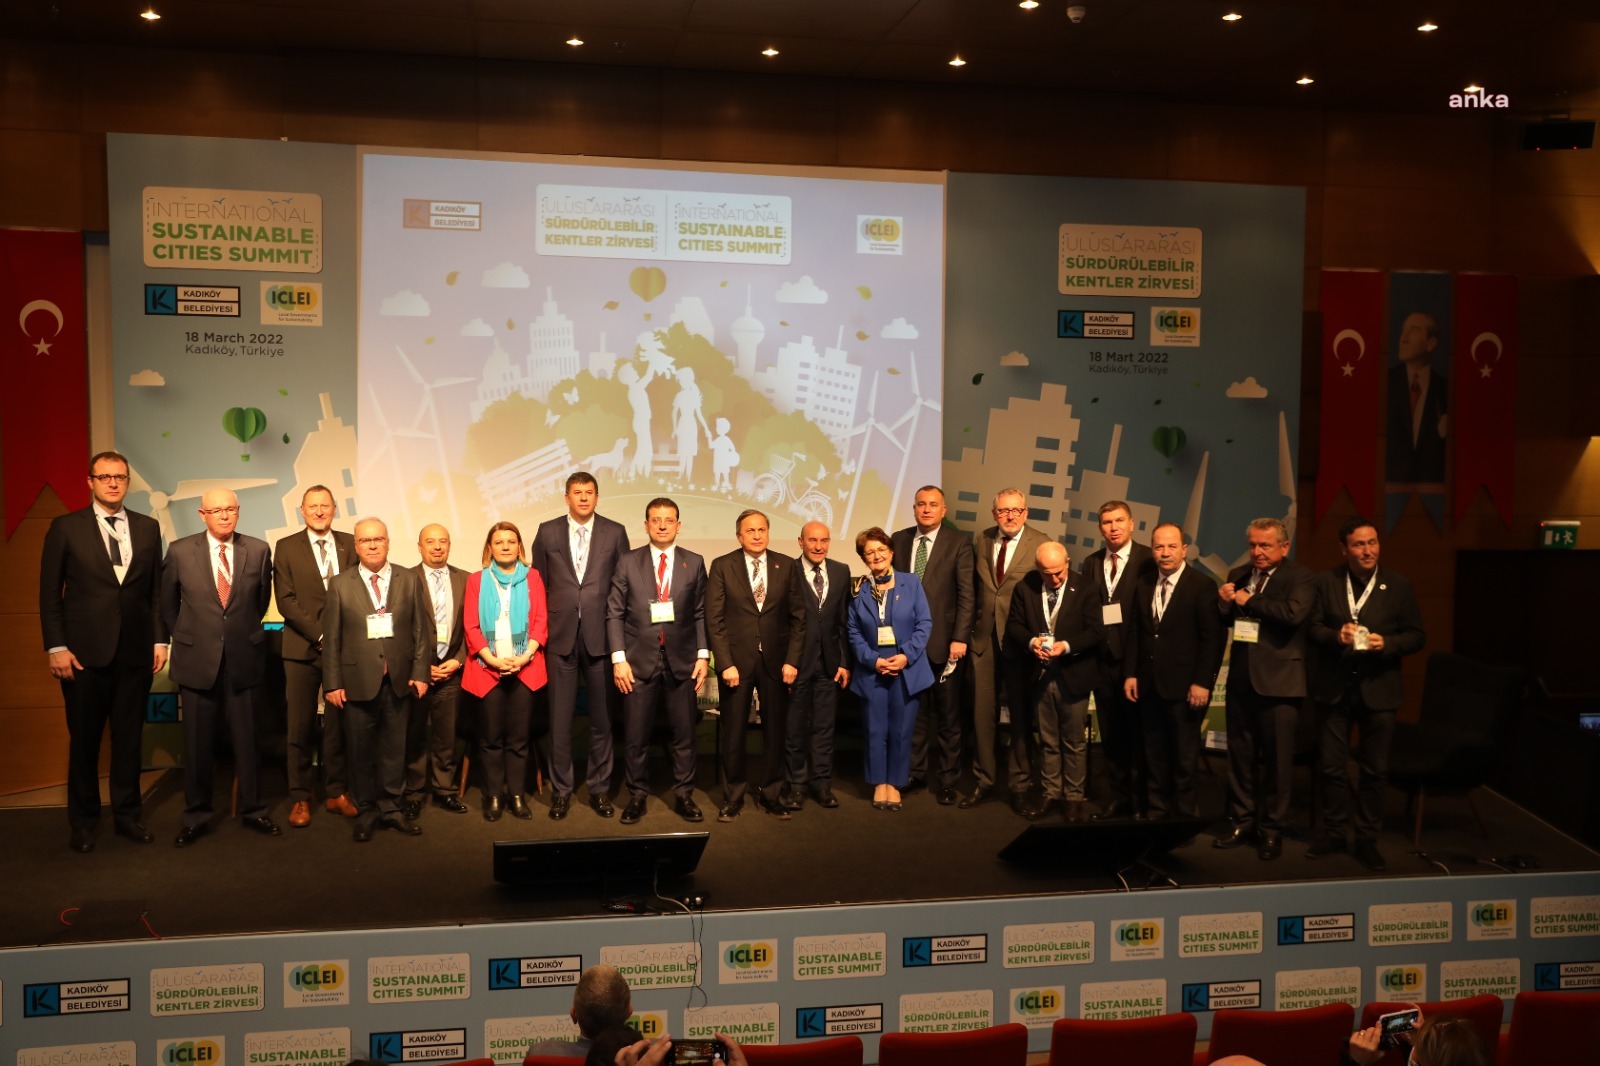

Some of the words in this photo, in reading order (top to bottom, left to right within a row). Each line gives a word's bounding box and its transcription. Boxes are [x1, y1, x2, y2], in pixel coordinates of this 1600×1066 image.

[152, 201, 314, 224] INTERNATIONAL
[435, 204, 466, 213] KADIKÖY
[545, 200, 655, 217] ULUSLARARASI
[678, 206, 783, 223] INTERNATIONAL
[434, 218, 476, 228] BELEDİYESİ
[545, 217, 655, 233] SÜRDÜRÜLEBİLİR
[865, 223, 895, 236] ICLEI
[152, 222, 314, 245] SUSTAINABLE
[678, 222, 784, 239] SUSTAINABLE
[545, 234, 603, 247] KENTLER
[606, 234, 655, 249] ZİRVESİ
[678, 239, 724, 252] CITIES
[727, 241, 782, 254] SUMMIT
[1066, 237, 1196, 255] ULUSLARARASI
[152, 244, 223, 261] CITIES
[228, 246, 313, 264] SUMMIT
[1066, 255, 1195, 272] SÜRDÜRÜLEBİLİR
[1066, 276, 1134, 288] KENTLER
[1138, 275, 1194, 290] ZİRVESİ
[183, 289, 221, 298] KADIKÖY
[271, 290, 311, 305] ICLEI
[183, 303, 233, 313] BELEDİYESİ
[1089, 314, 1119, 322] KADIKÖY
[1160, 315, 1191, 328] ICLEI
[185, 332, 199, 342] 18
[204, 332, 245, 344] March
[249, 333, 284, 345] 2022
[1088, 328, 1129, 336] BELEDİYESİ
[185, 344, 238, 357] Kadıköy,
[240, 345, 284, 357] Türkiye
[1090, 352, 1102, 362] 18
[1107, 352, 1134, 362] Mart
[1138, 353, 1169, 363] 2022
[1133, 365, 1168, 375] Türkiye
[1476, 908, 1507, 921] ICLEI
[1534, 912, 1600, 924] SUSTAINABL
[1309, 918, 1339, 926] KADIKÖY
[1373, 920, 1449, 932] SÜRDÜRÜLEBİLİR
[1534, 925, 1565, 934] CITIES
[1567, 923, 1600, 933] SUMMI
[1008, 928, 1090, 942] ULUSLARARASI
[1120, 927, 1154, 941] ICLEI
[1183, 930, 1259, 943] SUSTAINABLE
[1309, 930, 1349, 940] BELEDİYESİ
[1373, 932, 1412, 943] KENTLER
[1415, 931, 1449, 941] ZİRVESİ
[797, 940, 881, 953] INTERNATIONAL
[936, 938, 971, 948] KADIKÖY
[1008, 940, 1090, 954] SÜRDÜRÜLEBİLİR
[1183, 943, 1216, 954] CITIES
[1218, 940, 1258, 952] SUMMIT
[729, 949, 767, 963] ICLEI
[798, 951, 882, 965] SUSTAINABLE
[936, 952, 981, 961] BELEDİYESİ
[1008, 953, 1051, 964] KENTLER
[1054, 950, 1090, 962] ZİRVESİ
[372, 961, 466, 975] INTERNATIONAL
[526, 960, 564, 970] KADIKÖY
[798, 965, 834, 976] CITIES
[837, 963, 881, 974] SUMMIT
[1564, 965, 1594, 973] KADIKÖY
[156, 971, 259, 988] ULUSLARARASI
[295, 970, 337, 985] ICLEI
[372, 973, 466, 987] SUSTAINABLE
[526, 973, 575, 984] BELEDİYESİ
[1385, 972, 1417, 986] ICLEI
[1444, 975, 1517, 988] SUSTAINABLE
[1564, 977, 1600, 986] BELEDİYES
[67, 984, 109, 995] KADIKÖY
[156, 984, 258, 999] SÜRDÜRÜLEBİLİR
[373, 987, 413, 999] CITIES
[416, 985, 465, 997] SUMMIT
[1214, 985, 1245, 994] KADIKÖY
[1280, 986, 1357, 999] SÜRDÜRÜLEBİLİR
[1444, 989, 1476, 999] CITIES
[67, 999, 122, 1010] BELEDİYESİ
[156, 1001, 209, 1012] KENTLER
[213, 998, 258, 1009] ZİRVESİ
[904, 997, 989, 1011] ULUSLARARASI
[1020, 995, 1054, 1009] ICLEI
[1084, 998, 1163, 1011] SUSTAINABLE
[1213, 997, 1255, 1007] BELEDİYESİ
[1280, 999, 1320, 1009] KENTLER
[689, 1010, 774, 1024] INTERNATIONAL
[831, 1008, 866, 1018] KADIKÖY
[904, 1009, 989, 1023] SÜRDÜRÜLEBİLİR
[1084, 1011, 1118, 1020] CITIES
[1121, 1008, 1162, 1018] SUMMIT
[689, 1022, 775, 1036] SUSTAINABLE
[831, 1022, 876, 1032] BELEDİYESİ
[904, 1023, 949, 1033] KENTLER
[951, 1020, 989, 1031] ZİRVESİ
[249, 1036, 347, 1051] INTERNATIONAL
[409, 1034, 447, 1044] KADIKÖY
[734, 1034, 774, 1044] UMMIT
[169, 1046, 212, 1063] ICLEI
[249, 1048, 347, 1063] SUSTAINABLE
[408, 1048, 459, 1058] BELEDİYESİ
